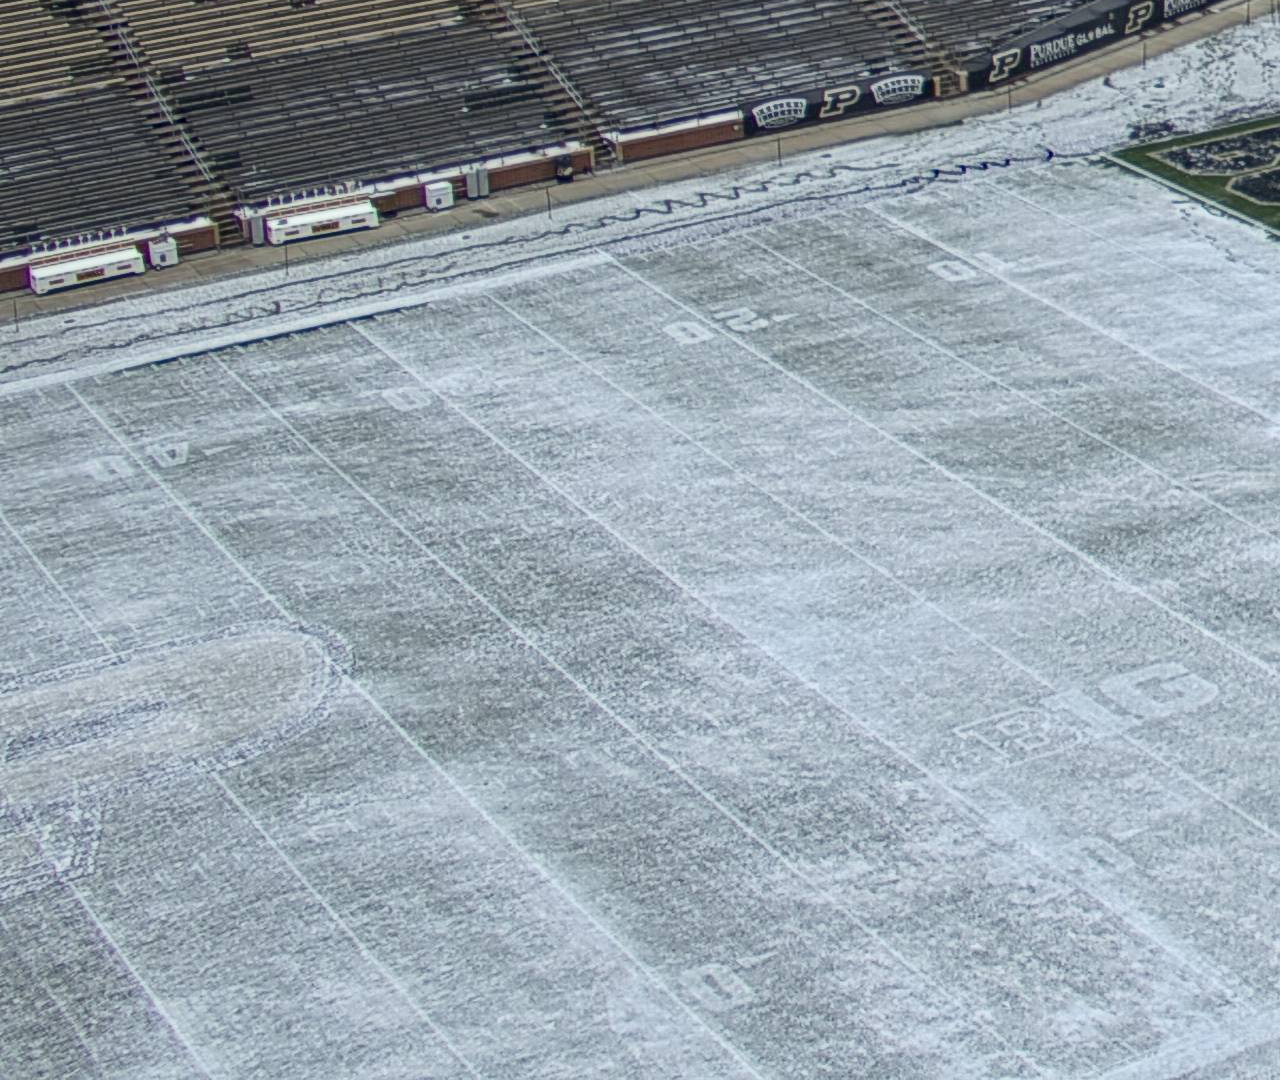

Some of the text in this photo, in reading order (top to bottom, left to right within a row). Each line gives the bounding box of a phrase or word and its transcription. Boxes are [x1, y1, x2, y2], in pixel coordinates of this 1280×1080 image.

[1125, 0, 1154, 34] P
[989, 48, 1022, 83] P
[820, 85, 861, 118] P
